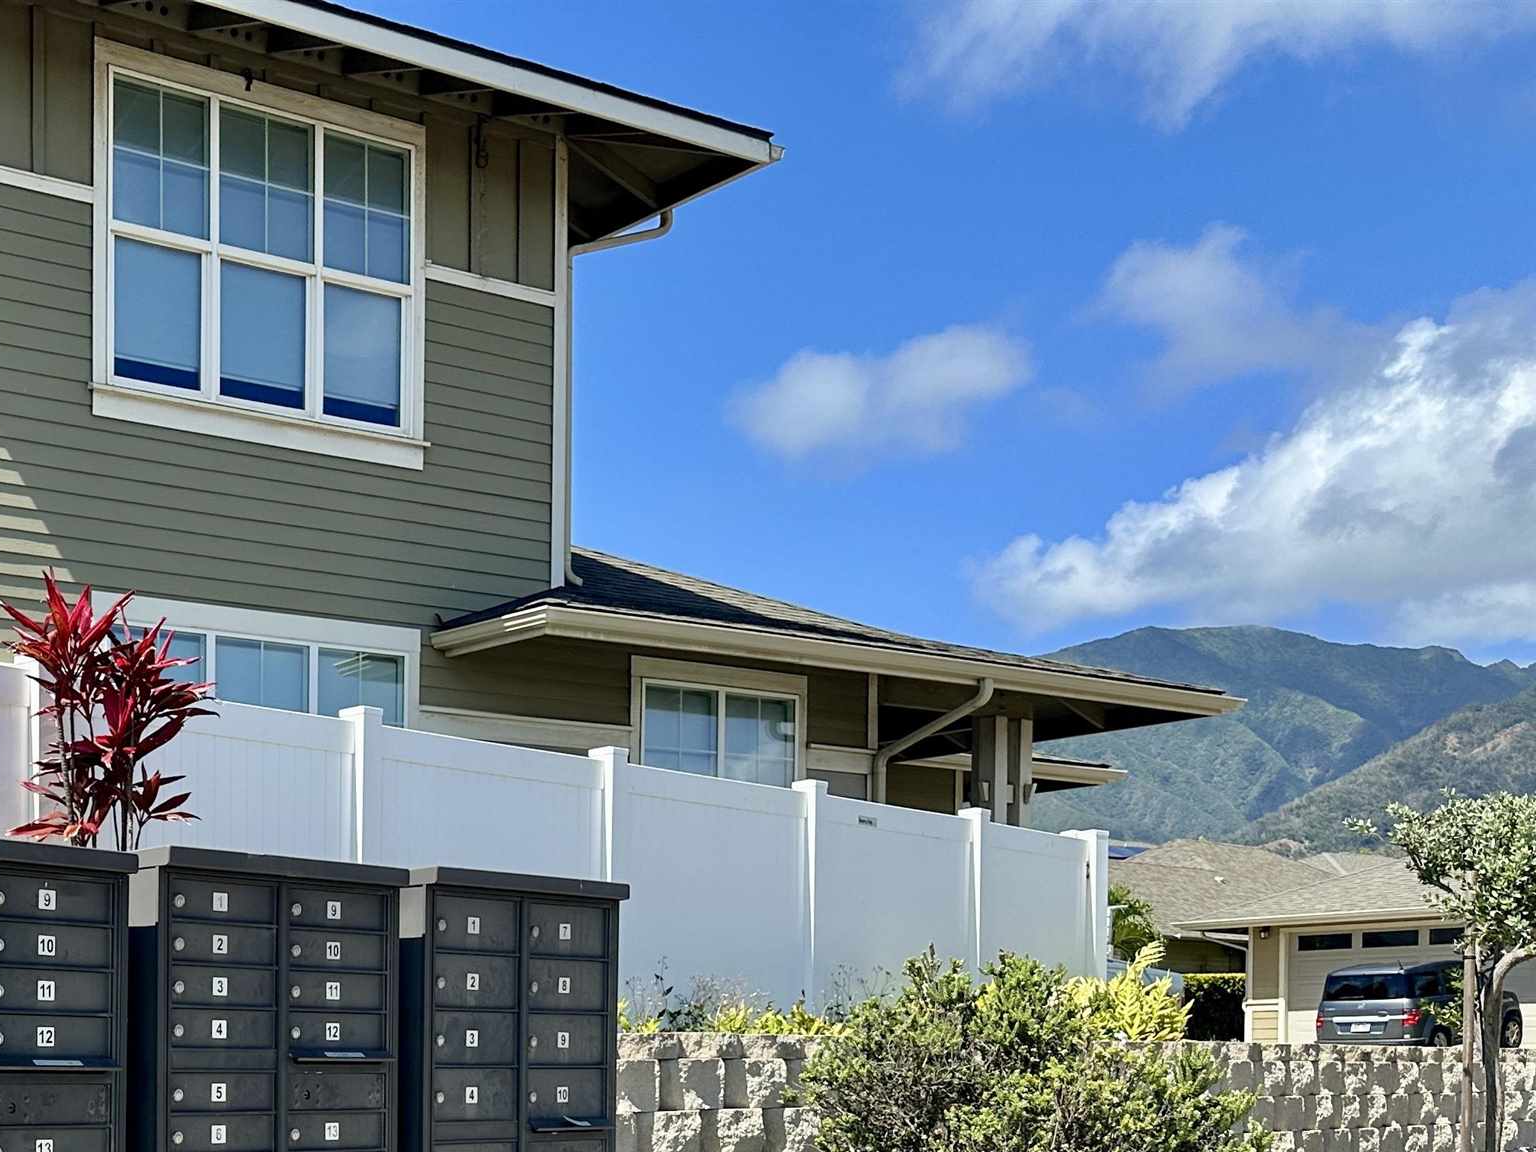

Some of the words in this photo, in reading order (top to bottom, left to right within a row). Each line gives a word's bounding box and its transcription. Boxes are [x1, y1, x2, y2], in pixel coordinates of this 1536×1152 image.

[43, 893, 51, 907] 9
[39, 938, 54, 954] 10
[39, 983, 52, 998] 11
[38, 1029, 53, 1044] 12
